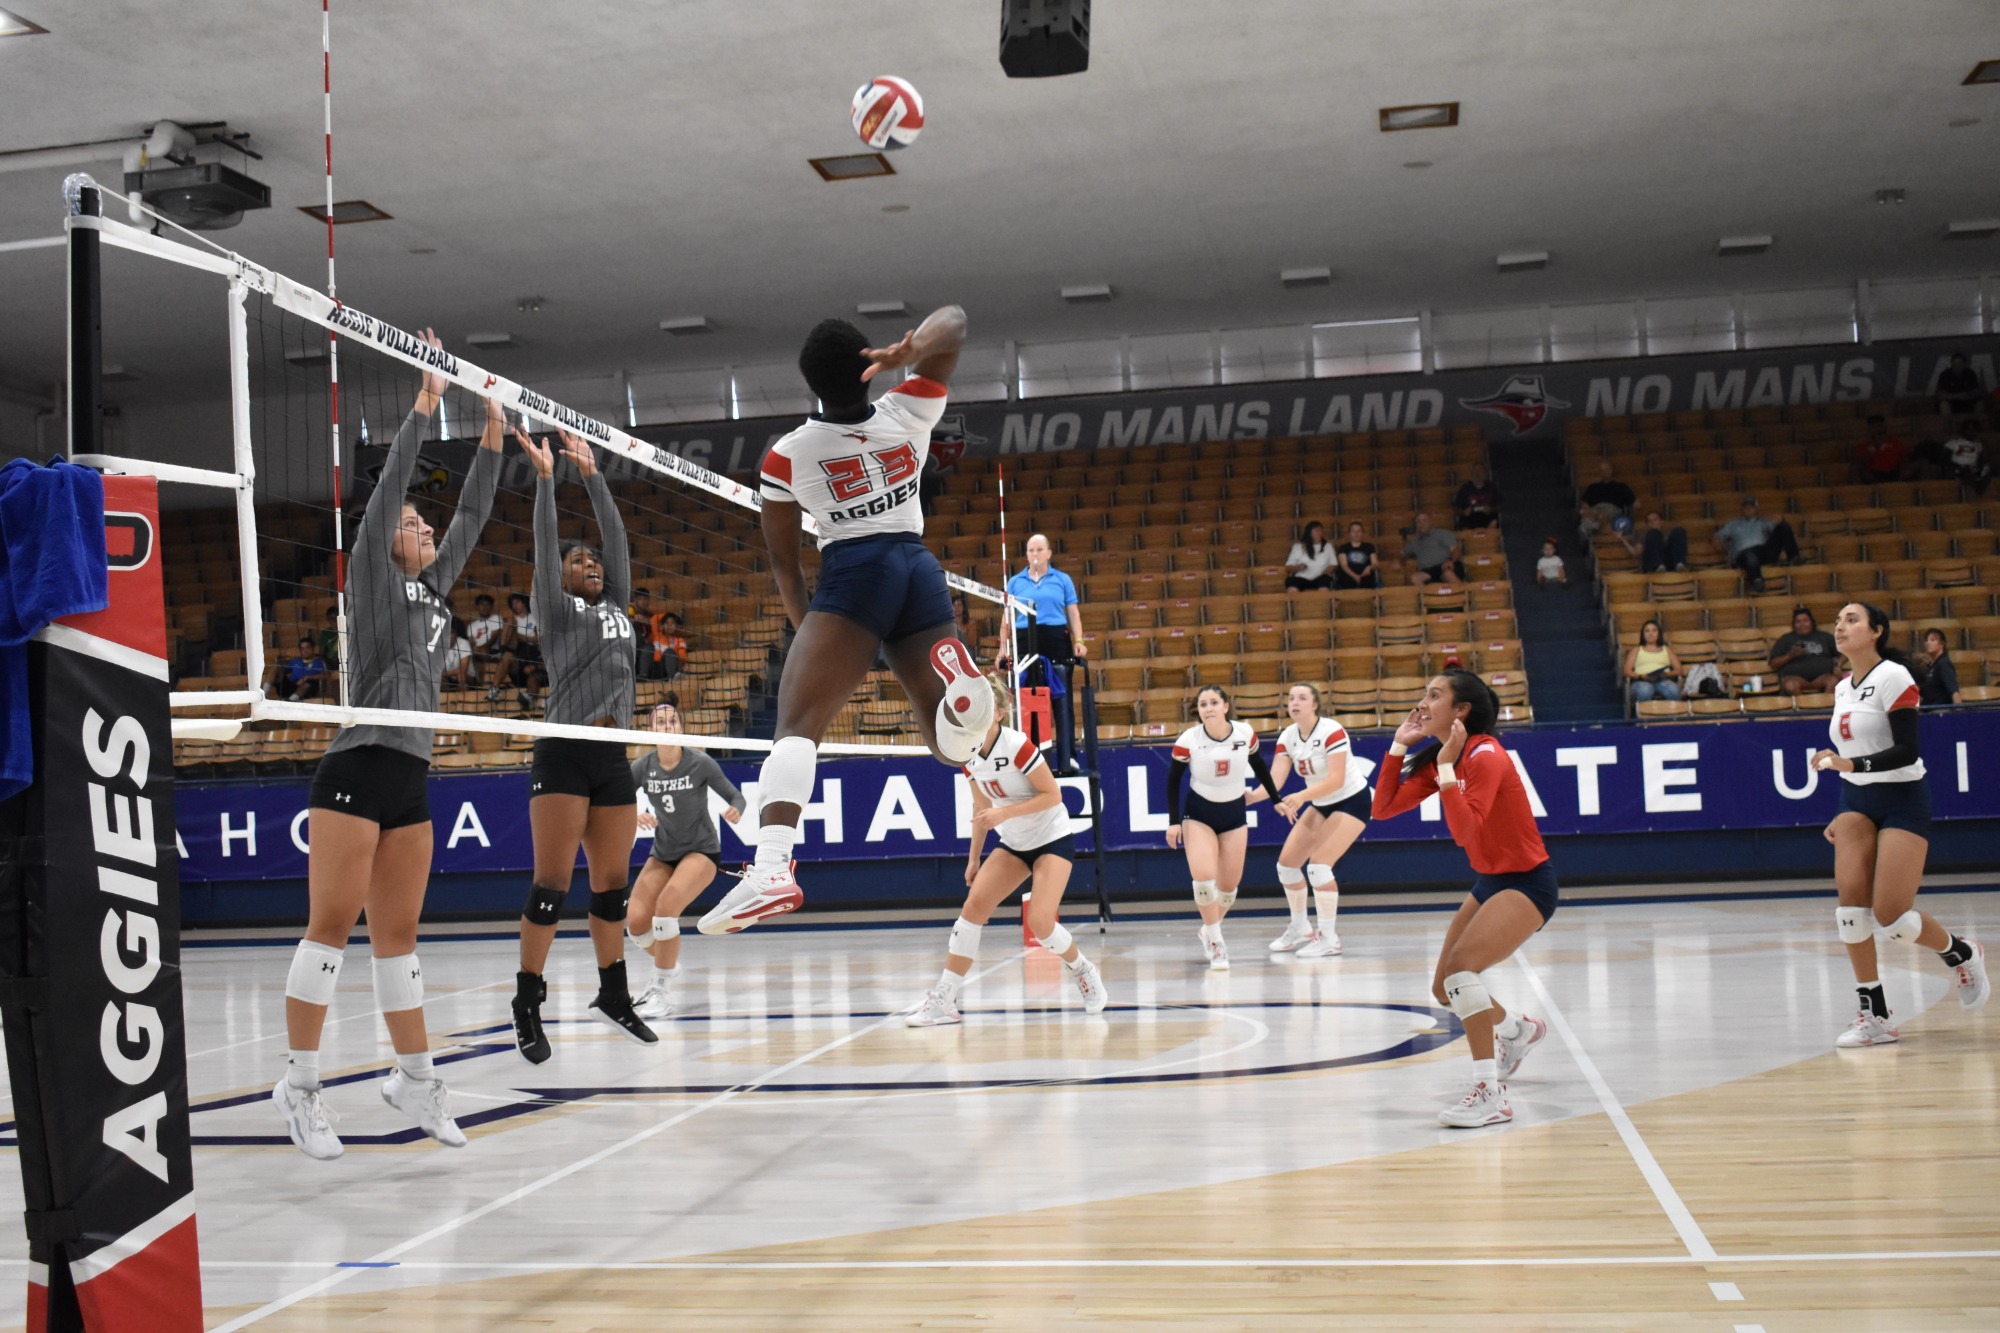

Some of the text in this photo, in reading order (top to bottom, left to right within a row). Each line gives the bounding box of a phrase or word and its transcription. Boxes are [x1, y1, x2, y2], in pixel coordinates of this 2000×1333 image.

[326, 307, 459, 377] AGGIE VOLLEYBALL
[1586, 373, 1673, 417] NO
[1690, 357, 1876, 411] MANS
[518, 386, 612, 442] AGGIE VOLLEYBALL
[999, 389, 1444, 455] NO MANS LAND
[651, 447, 721, 490] AGGIE VOLLEYBALL
[818, 440, 919, 503] 23
[827, 476, 918, 523] AGGIES
[427, 614, 447, 653] 7
[598, 610, 631, 639] 20
[1840, 712, 1854, 741] 6
[647, 775, 694, 794] BETHEL
[1214, 759, 1230, 777] 9
[1298, 759, 1316, 776] 21
[662, 794, 676, 814] 3
[982, 779, 1007, 799] 10
[82, 706, 169, 1184] AGGIES
